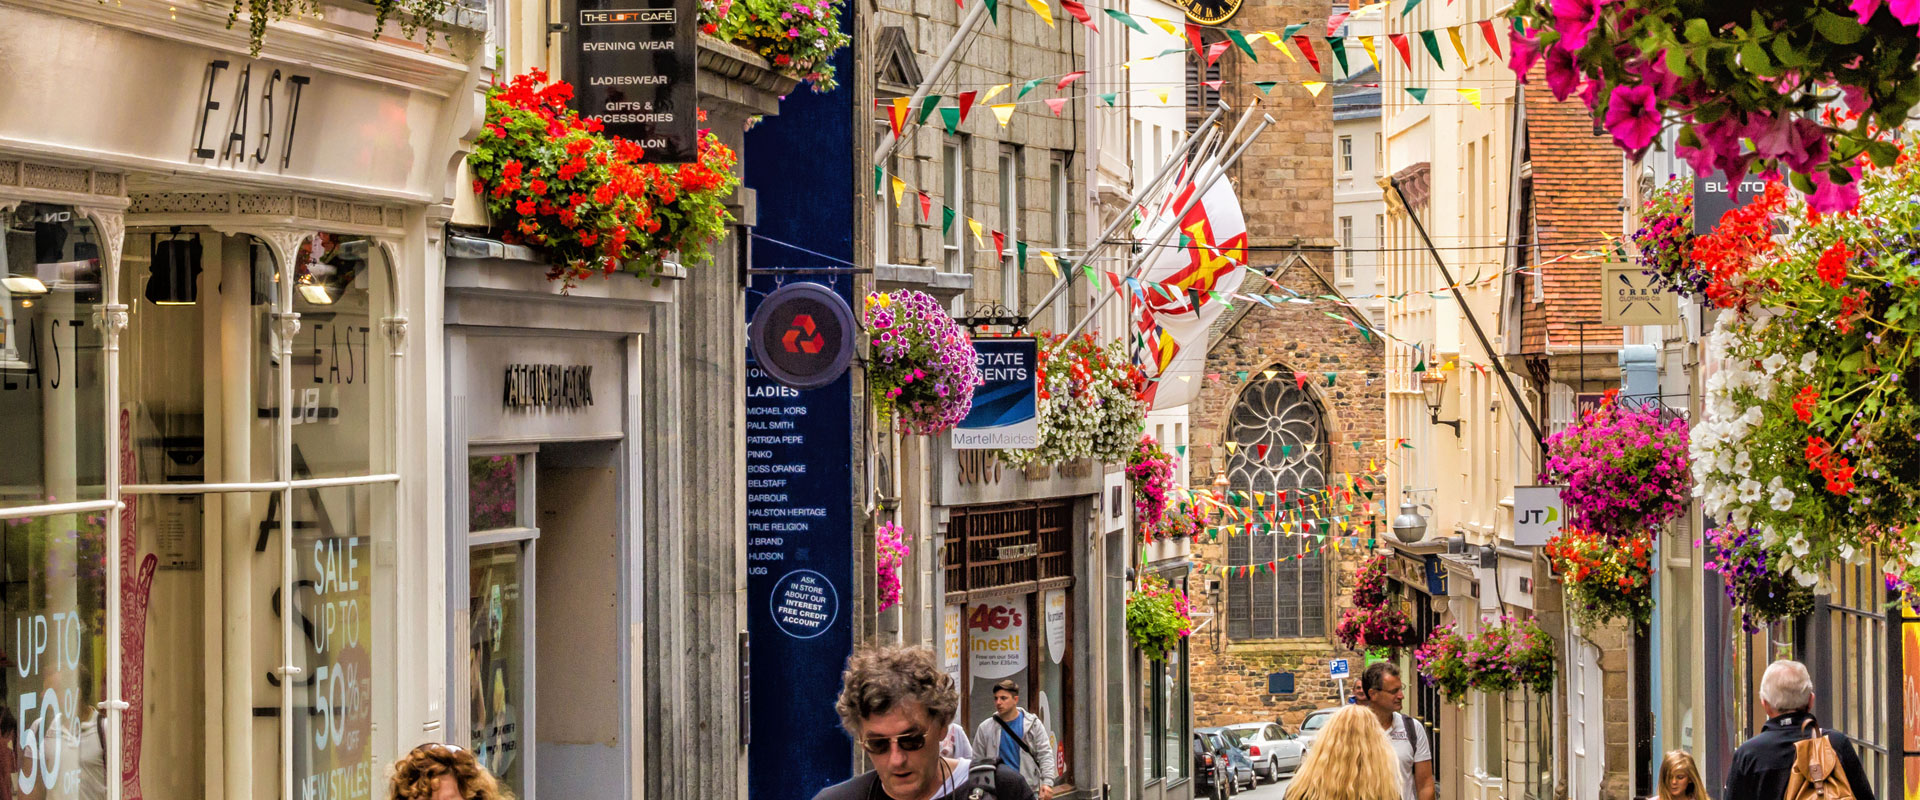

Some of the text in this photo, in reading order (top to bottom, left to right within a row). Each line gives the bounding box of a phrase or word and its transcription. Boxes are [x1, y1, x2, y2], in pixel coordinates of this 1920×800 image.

[585, 11, 673, 22] THE LOFT CAFÉ
[583, 41, 674, 51] EVENING WEAR
[590, 76, 668, 85] LADIESWEAR
[605, 102, 653, 111] GIFTS &
[196, 60, 311, 169] EAST
[587, 114, 673, 123] ACCESSORIES
[1705, 182, 1765, 192] BUTO
[1618, 288, 1661, 296] CREW
[4, 317, 84, 390] EAST
[314, 324, 369, 384] EAST
[974, 352, 1024, 365] STATE
[978, 368, 1027, 381] GENTS
[747, 386, 799, 397] LADIES
[747, 407, 807, 415] MICHAEL KORS
[747, 422, 795, 430] PAUL SMITH
[747, 436, 804, 444] PATRIZIA PEPE
[954, 432, 1036, 445] MartelMaides
[747, 450, 773, 459] PINKO
[748, 465, 806, 473] BOSS ORANGE
[748, 480, 787, 488] BELSTAFF
[748, 494, 788, 502] BARBOUR
[748, 508, 827, 517] HALSTON HERITAGE
[1518, 510, 1544, 525] JT
[748, 523, 809, 531] TRUE RELIGION
[748, 538, 784, 546] J BRAND
[748, 552, 784, 560] HUDSON
[314, 537, 359, 596] SALE
[749, 567, 768, 575] UGG
[801, 576, 816, 585] ASK
[799, 584, 824, 595] STORE
[784, 590, 826, 603] ABOUT OUR
[786, 599, 823, 611] INTEREST
[778, 606, 829, 621] FREE CREDIT
[969, 603, 1022, 632] 4G's
[314, 599, 359, 655] UP TO
[783, 616, 820, 628] ACCOUNT
[17, 611, 81, 678] UP TO
[970, 634, 1020, 651] inest!
[1331, 661, 1338, 671] P
[316, 662, 360, 750] 50%
[18, 687, 81, 795] 50%
[63, 769, 81, 795] OFF
[302, 762, 369, 800] NEW STYLES
